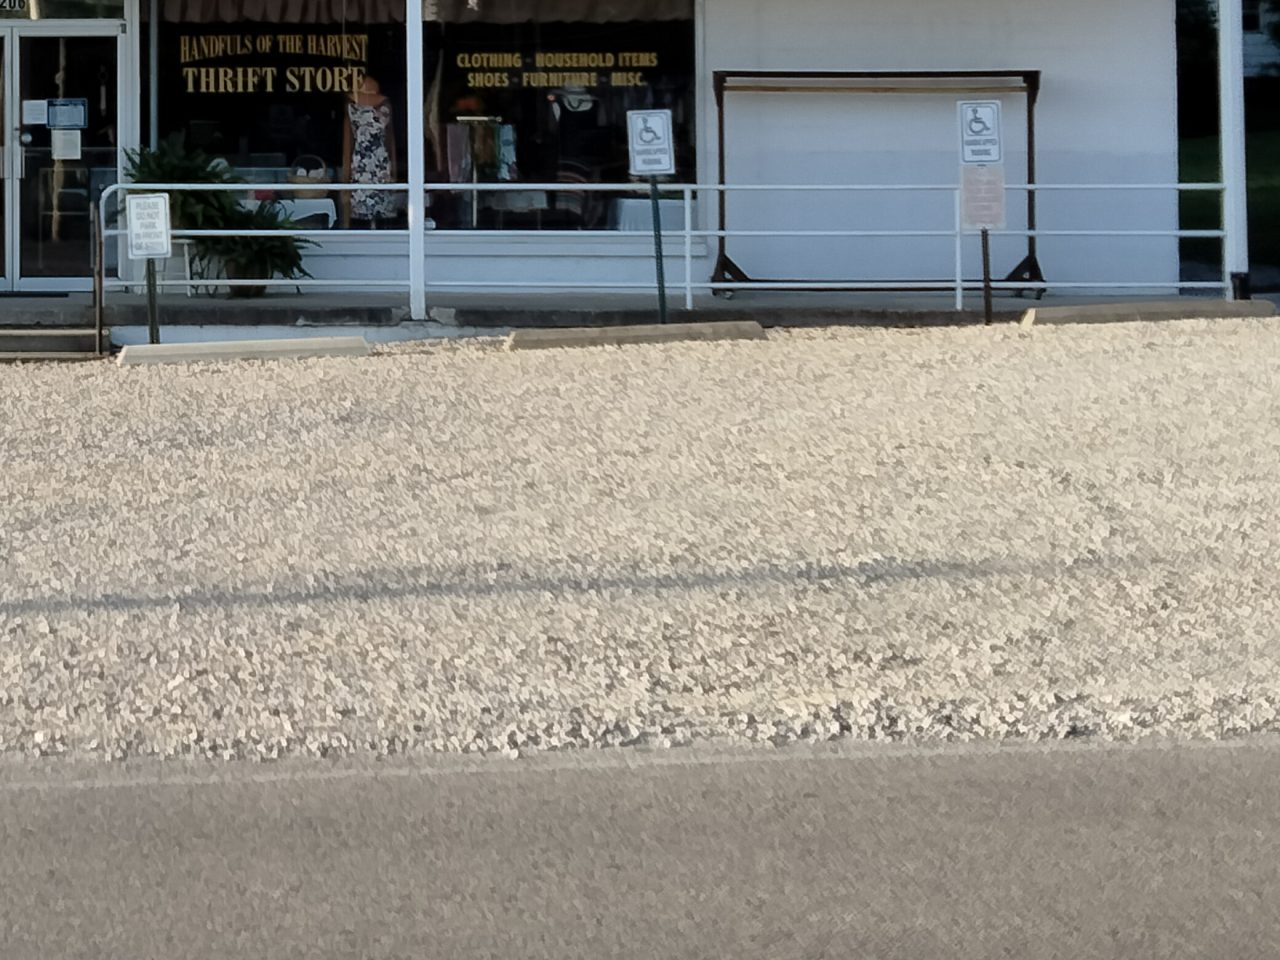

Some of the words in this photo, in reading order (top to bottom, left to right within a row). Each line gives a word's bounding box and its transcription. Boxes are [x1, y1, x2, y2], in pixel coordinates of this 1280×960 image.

[180, 34, 253, 64] HANDFULS
[256, 34, 272, 54] OF
[276, 34, 304, 54] THE
[307, 34, 369, 62] HARVEST
[456, 52, 522, 68] CLOTHING
[535, 52, 614, 68] HOUSEHOLD
[619, 52, 658, 67] ITEMS
[183, 67, 277, 93] THRIFT
[285, 66, 366, 93] STORE
[467, 72, 509, 87] SHOES
[522, 72, 597, 87] FURNITURE
